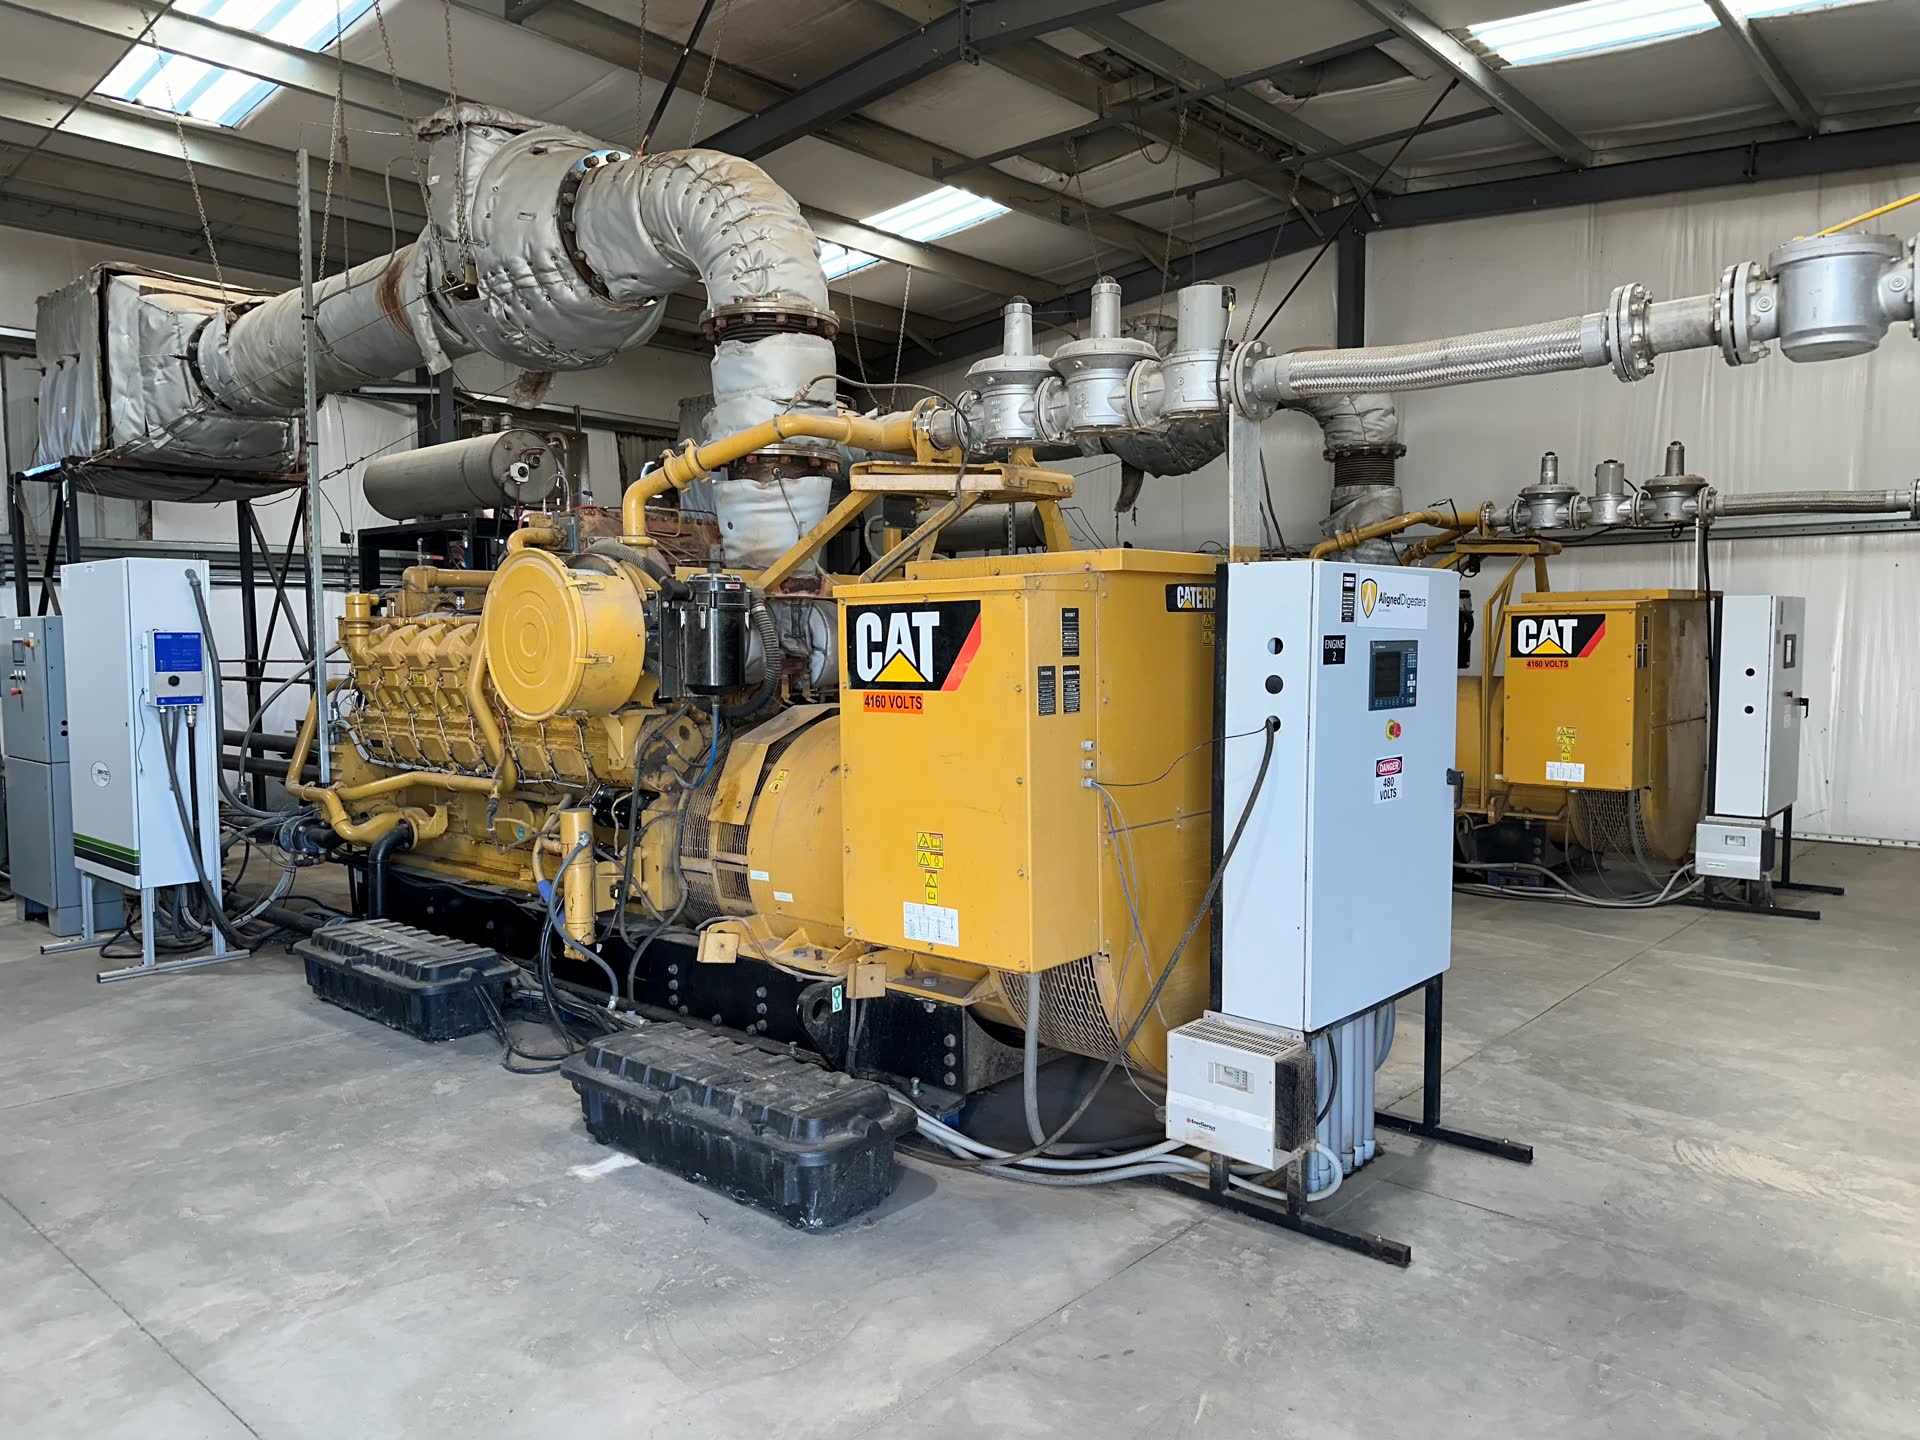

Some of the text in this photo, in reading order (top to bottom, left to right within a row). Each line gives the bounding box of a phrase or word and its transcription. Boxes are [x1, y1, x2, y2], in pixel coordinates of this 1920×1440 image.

[1378, 592, 1427, 609] AlignedDigesters
[1517, 618, 1578, 655] CAT
[855, 611, 940, 683] CAT
[1324, 639, 1345, 650] ENGINE
[1332, 651, 1337, 662] 2
[1526, 660, 1569, 668] 4160 VOLTS
[864, 695, 923, 710] 4160 VOLTS
[1379, 761, 1399, 773] DANGER
[1382, 776, 1395, 788] 480
[1379, 787, 1397, 801] VOLTS
